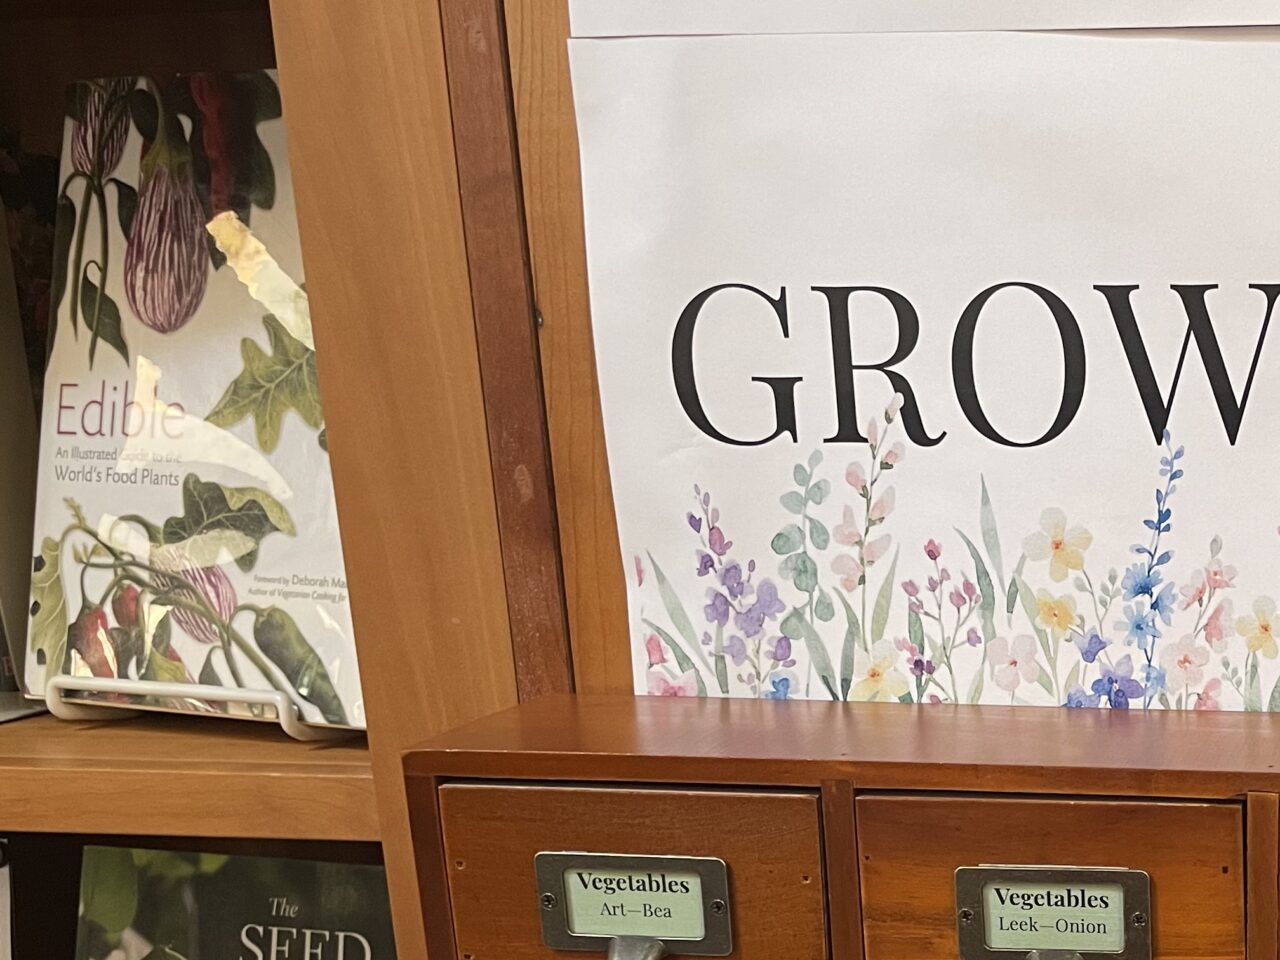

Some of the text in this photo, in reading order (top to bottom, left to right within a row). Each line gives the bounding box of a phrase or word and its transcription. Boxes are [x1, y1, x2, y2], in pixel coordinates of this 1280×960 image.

[57, 379, 184, 439] Edible
[56, 446, 68, 459] An
[71, 446, 117, 461] Illustrated
[55, 465, 180, 486] World's Food Plants
[292, 574, 329, 587] Deborah
[577, 872, 690, 894] Vegetables
[269, 897, 298, 917] The
[994, 887, 1110, 910] Vegetables
